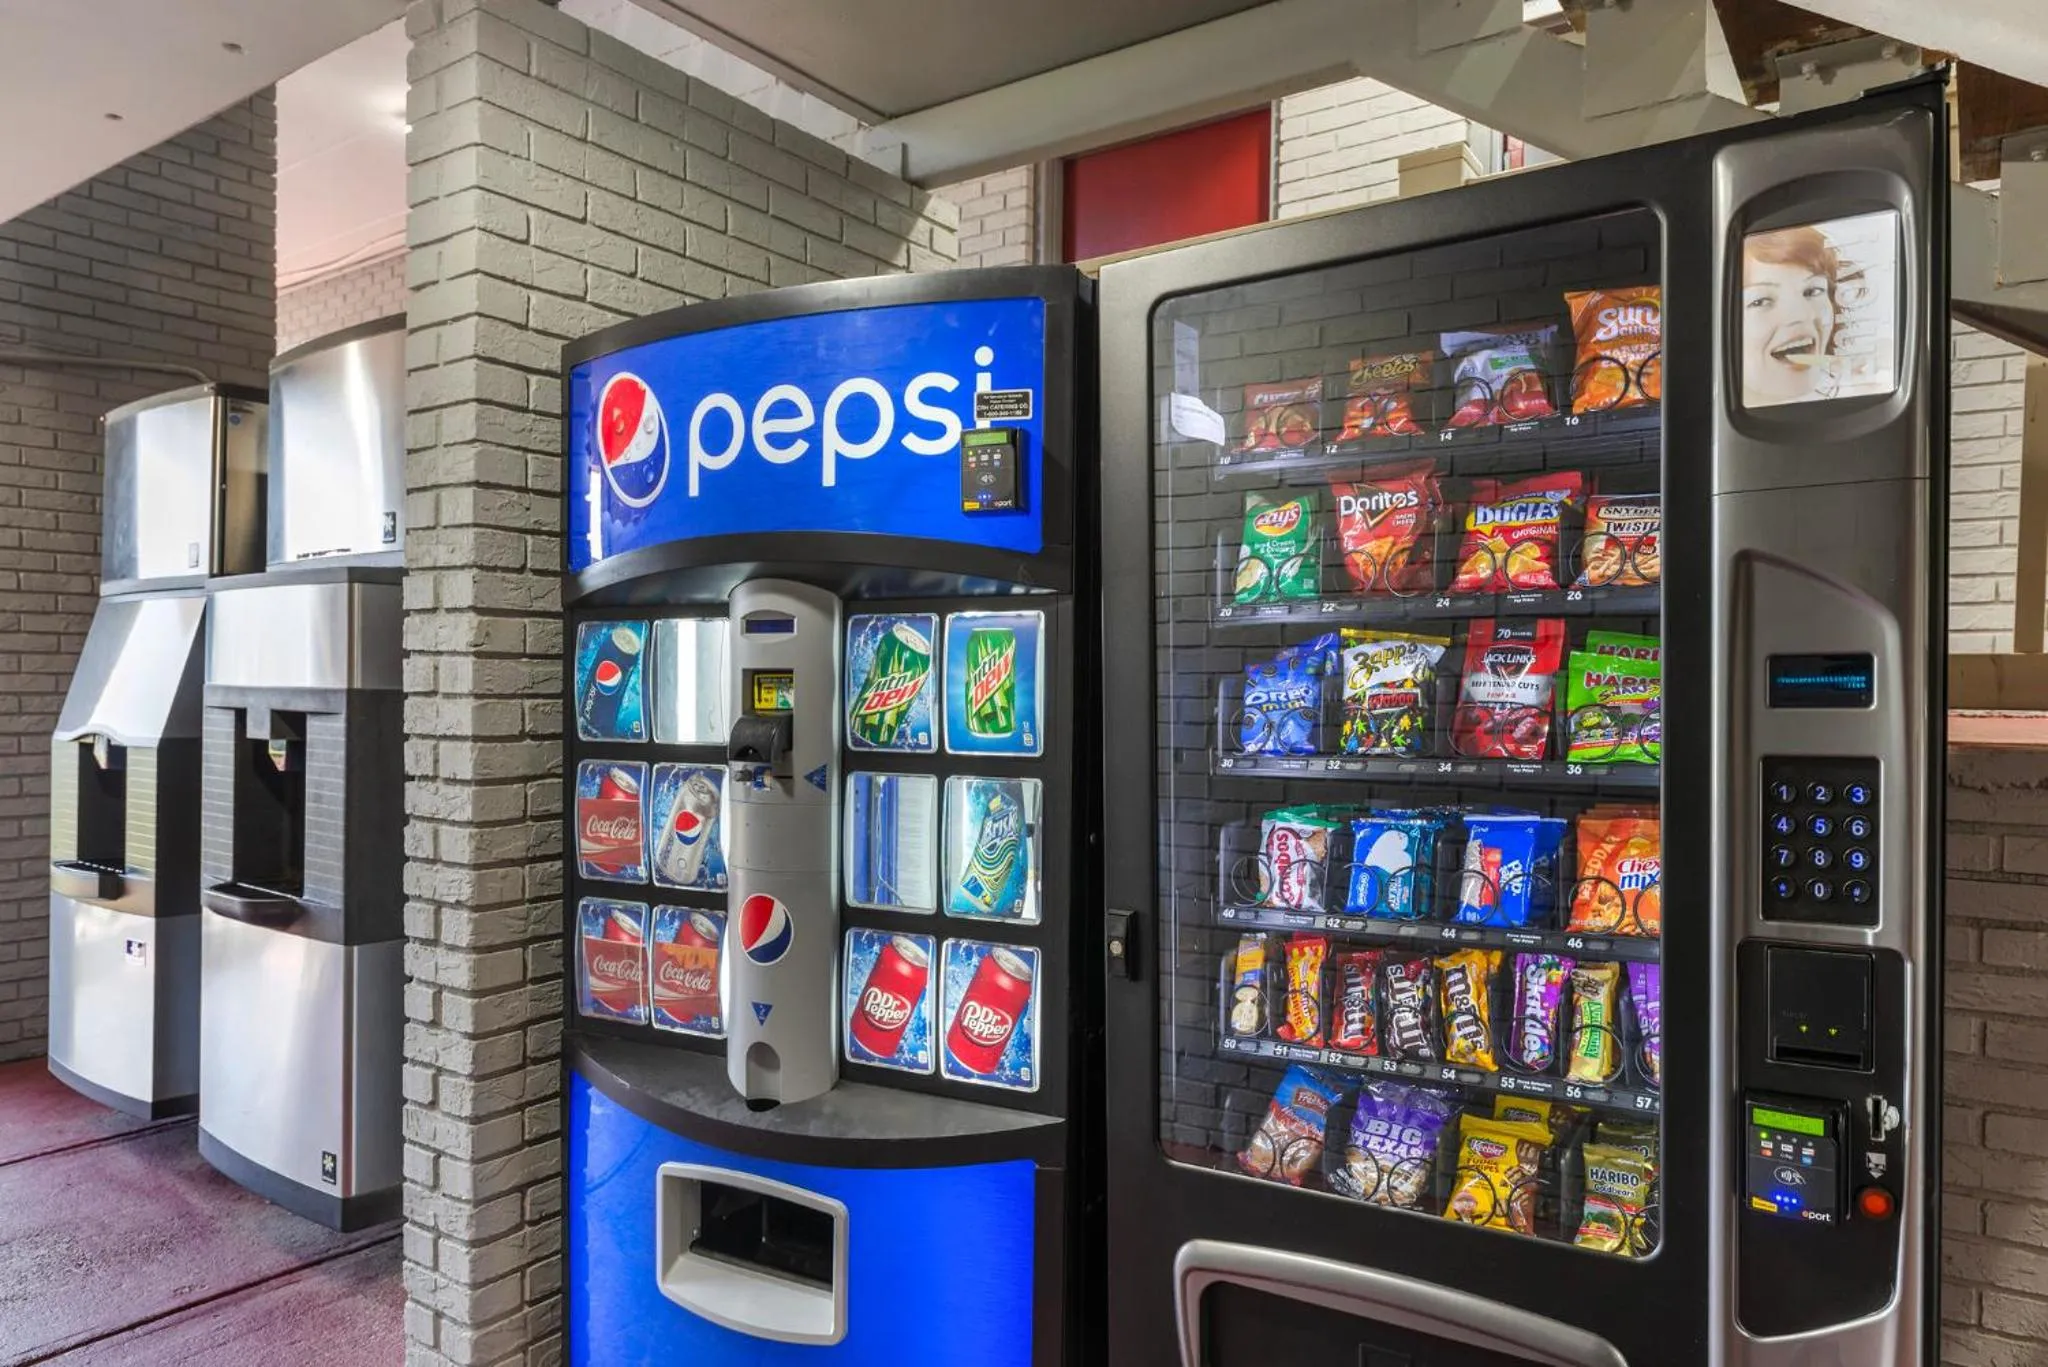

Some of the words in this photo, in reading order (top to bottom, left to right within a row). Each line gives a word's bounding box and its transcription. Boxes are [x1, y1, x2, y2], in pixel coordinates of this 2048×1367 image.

[1351, 354, 1419, 385] Cheetos
[688, 346, 994, 497] pepsi
[1564, 417, 1579, 426] 16
[1440, 432, 1453, 441] 14
[1326, 445, 1338, 454] 12
[1340, 490, 1418, 516] Doritos
[1567, 591, 1582, 600] 26
[1322, 604, 1336, 612] 22
[1436, 598, 1450, 608] 24
[1220, 608, 1232, 616] 20
[1496, 629, 1511, 639] 70
[1222, 759, 1233, 768] 30
[1327, 761, 1340, 770] 32
[1438, 763, 1452, 772] 34
[1567, 765, 1582, 774] 36
[1779, 786, 1788, 799] 1
[1816, 786, 1825, 800] 2
[1853, 787, 1864, 802] 3
[1777, 817, 1787, 832] 4
[1815, 818, 1825, 834] 5
[1852, 820, 1863, 835] 6
[1778, 850, 1788, 864] 7
[1814, 851, 1824, 866] 8
[1852, 852, 1863, 868] 9
[1617, 858, 1660, 874] Chex
[1814, 882, 1824, 896] 0
[1223, 909, 1234, 918] 40
[1326, 918, 1340, 928] 42
[1442, 928, 1456, 938] 44
[1567, 938, 1583, 948] 46
[864, 987, 908, 1021] Pepper
[879, 994, 900, 1009] Dr
[980, 1007, 1000, 1023] Dr
[1522, 963, 1547, 1062] Skittles
[962, 1001, 1010, 1038] Pepper
[1224, 1039, 1236, 1048] 50
[1330, 1053, 1342, 1062] 52
[1384, 1061, 1396, 1071] 53
[1442, 1070, 1456, 1080] 54
[1501, 1076, 1515, 1089] 55
[1566, 1088, 1582, 1098] 56
[1636, 1096, 1652, 1108] 57
[1367, 1118, 1423, 1146] BIG
[1355, 1131, 1423, 1157] TEXAS
[1590, 1168, 1640, 1187] HARIBO
